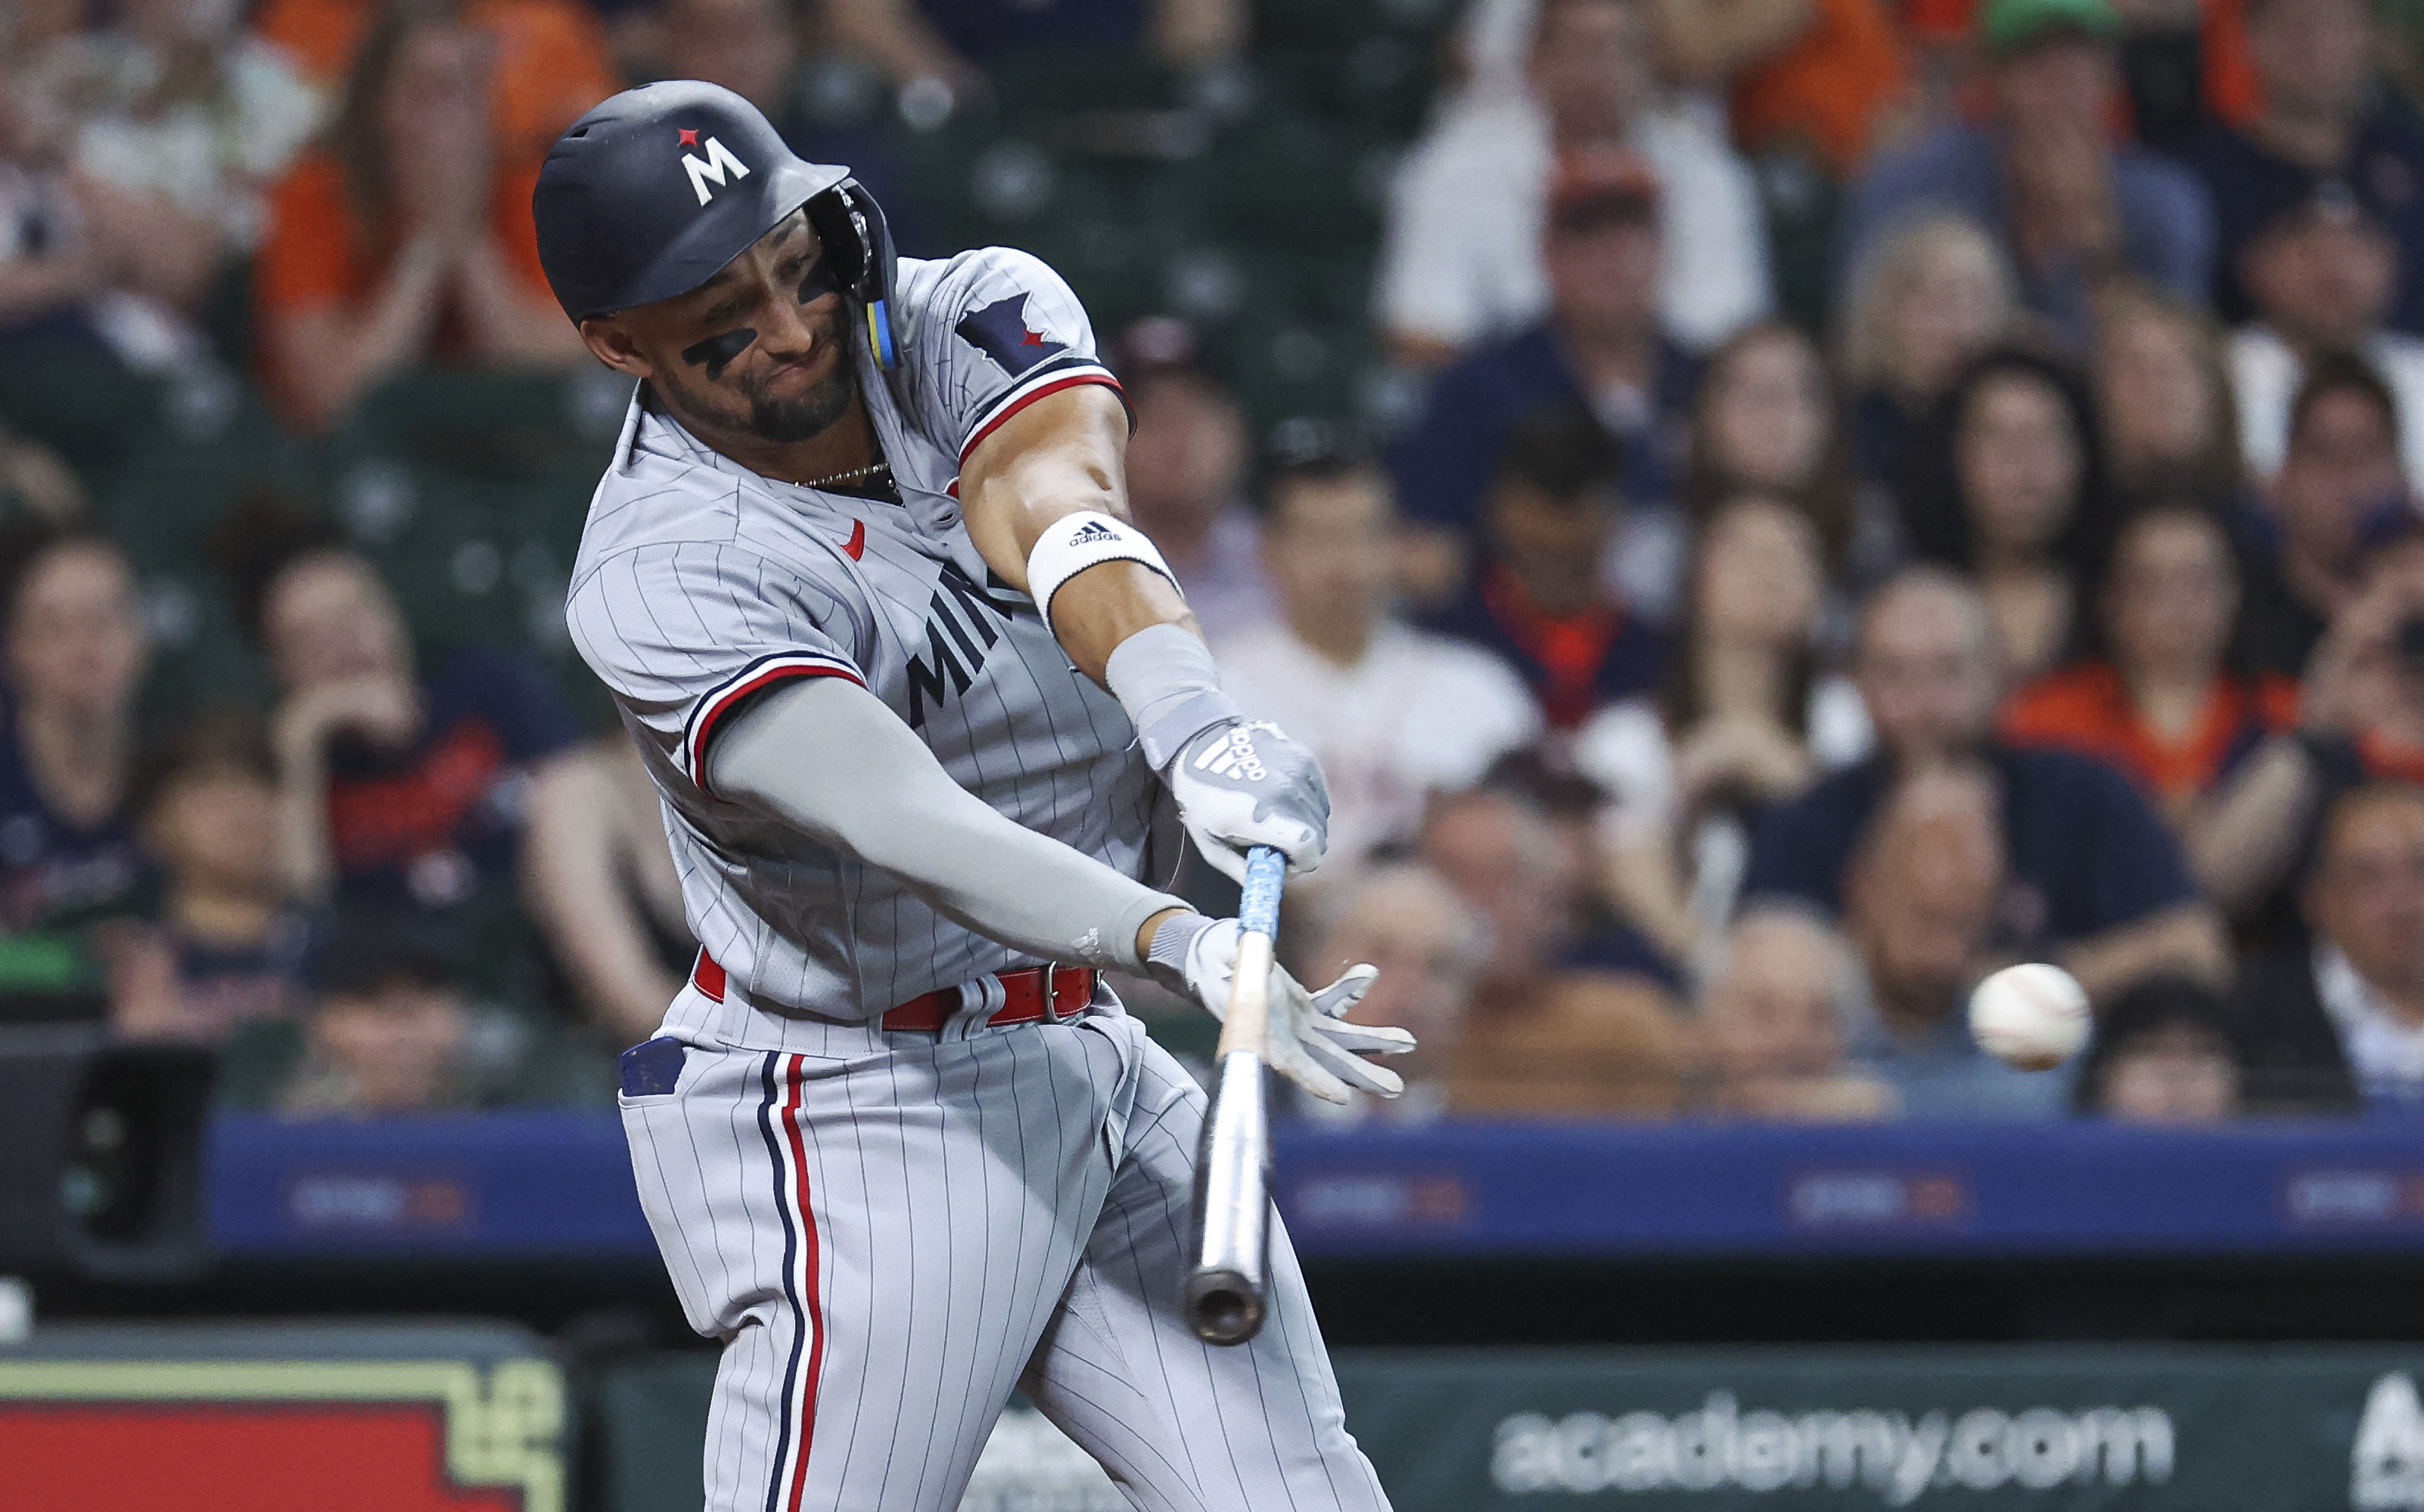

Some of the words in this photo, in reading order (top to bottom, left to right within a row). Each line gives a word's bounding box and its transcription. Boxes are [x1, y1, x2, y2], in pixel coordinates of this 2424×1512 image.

[682, 136, 750, 206] M
[1069, 532, 1122, 546] adidas
[1490, 1389, 2175, 1505] academy.com
